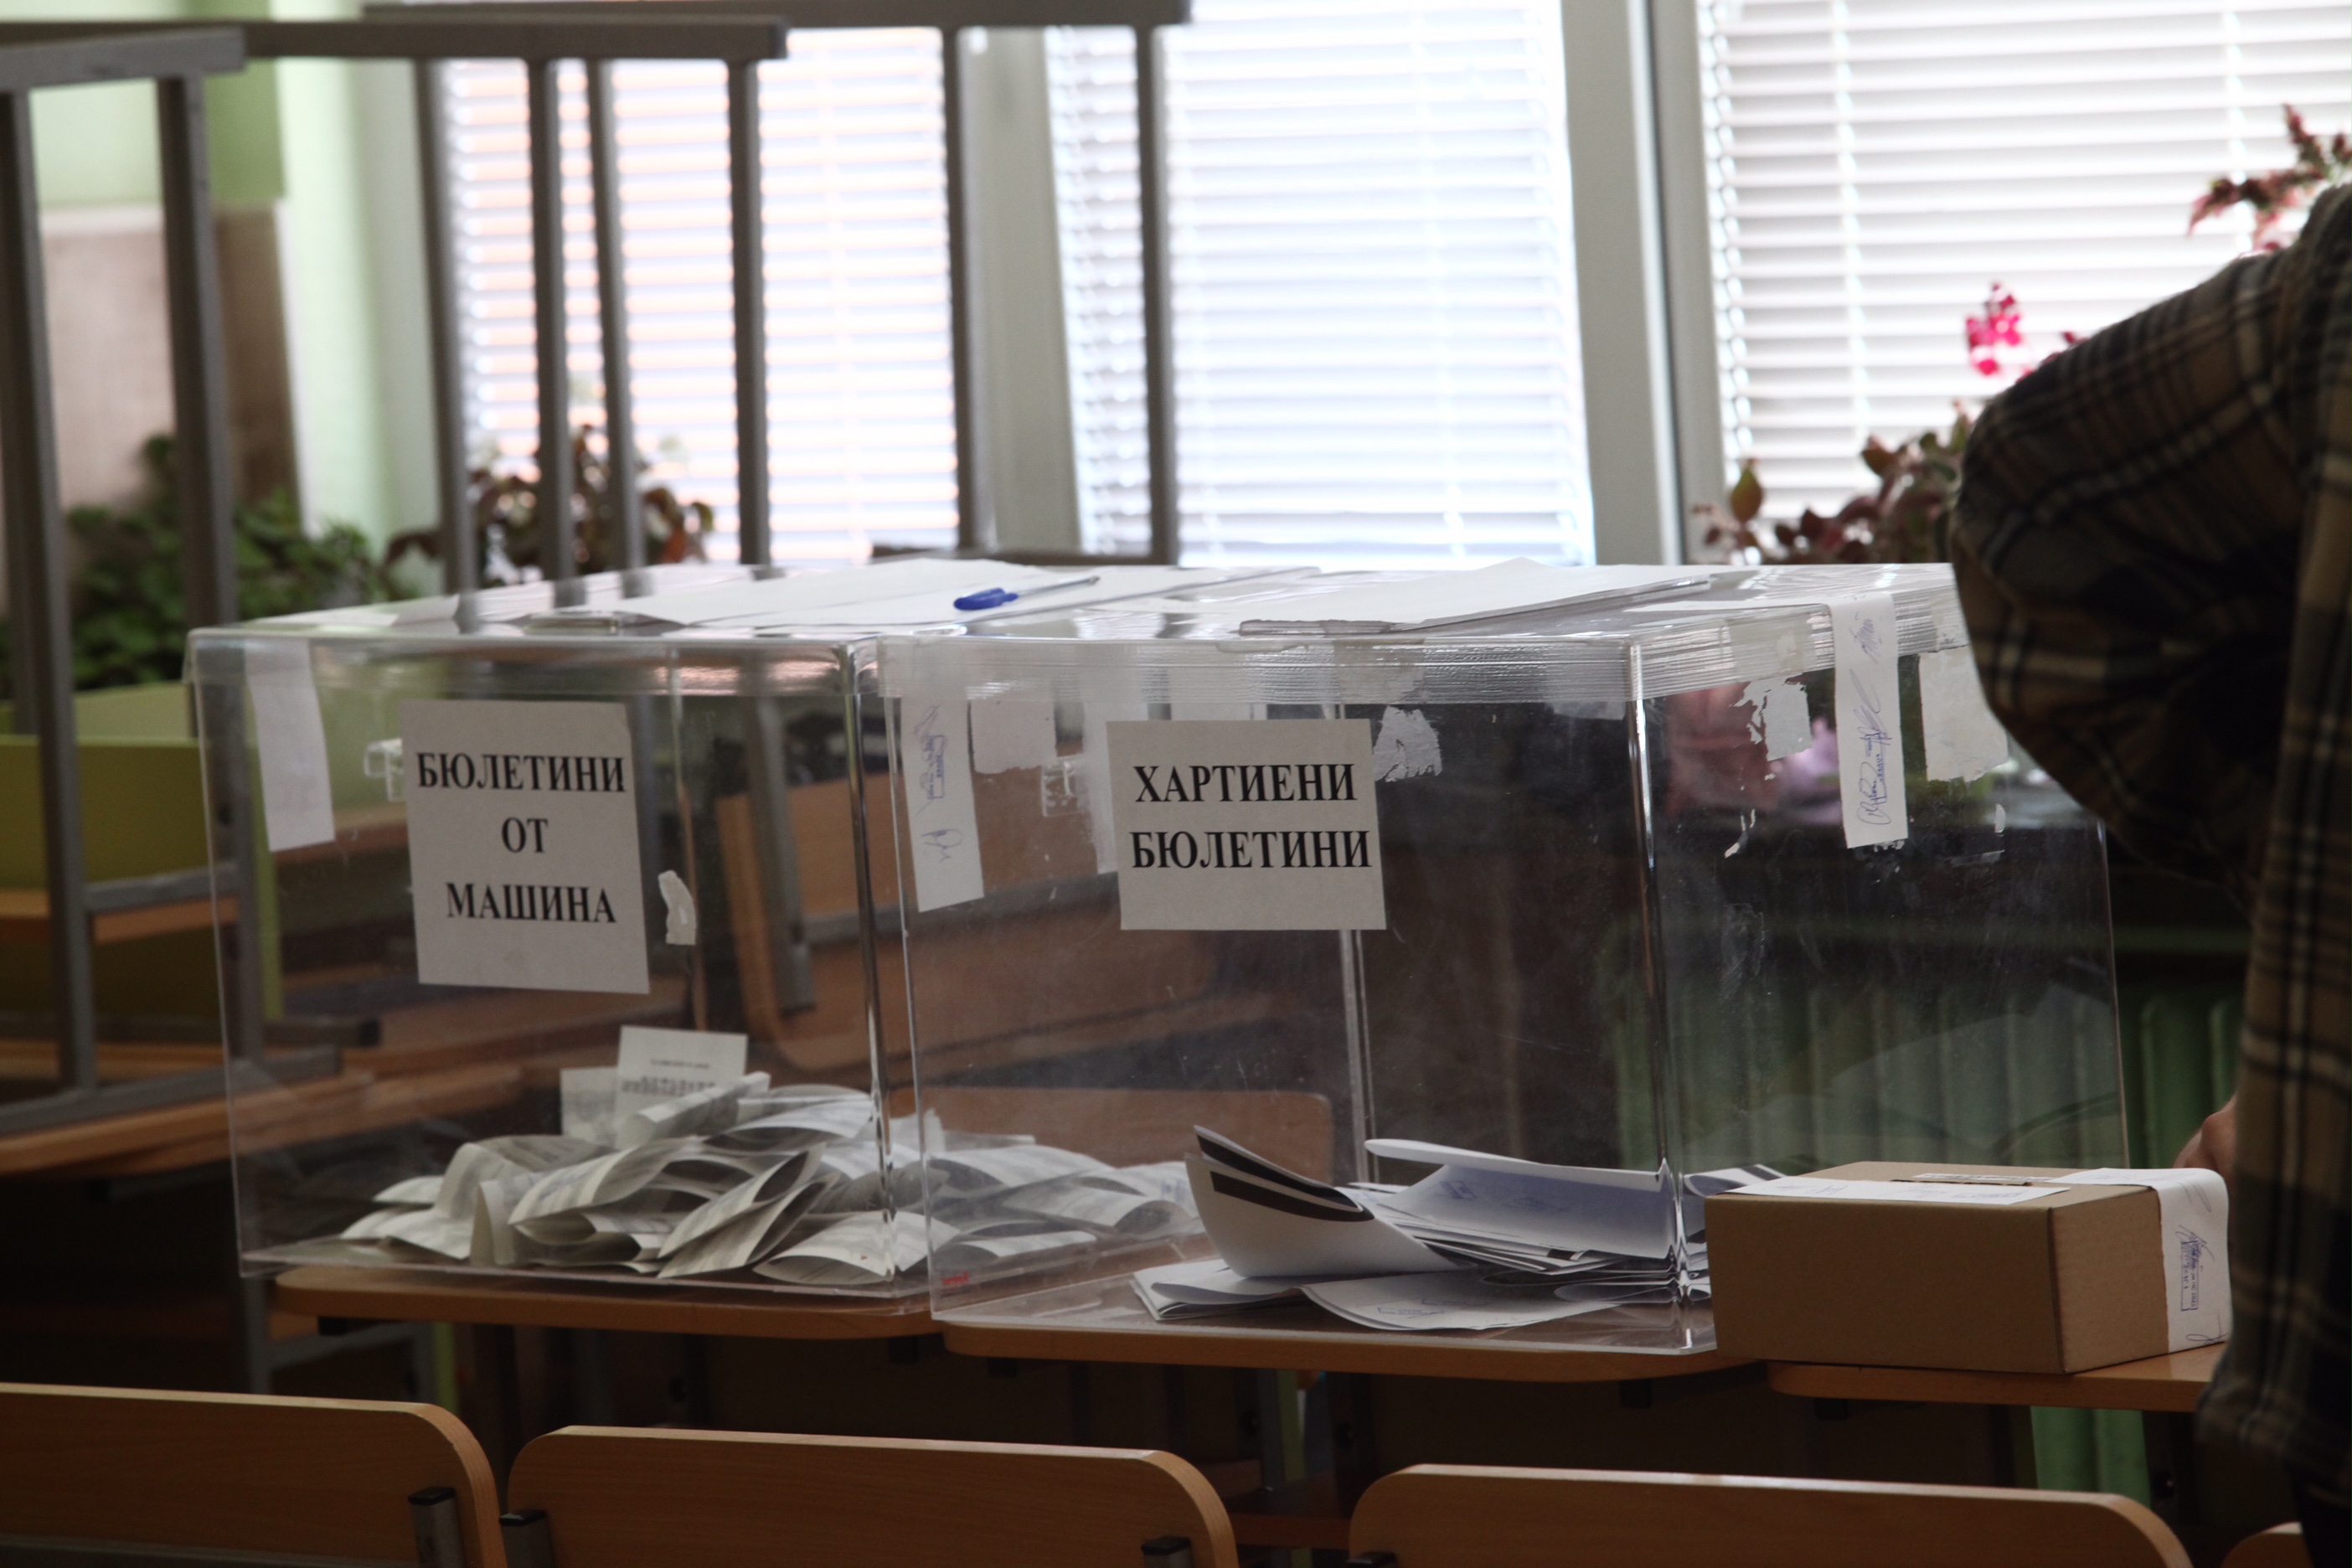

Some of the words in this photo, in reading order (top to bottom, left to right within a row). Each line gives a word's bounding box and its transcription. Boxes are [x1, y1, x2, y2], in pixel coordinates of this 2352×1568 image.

[417, 753, 625, 793] БЮЛЕТИНИ
[1133, 763, 1358, 802] ХАРТИЕНИ
[501, 817, 549, 854] ОТ
[1130, 830, 1372, 869] БЮЛЕТИНИ
[446, 882, 616, 923] МАШИНА
